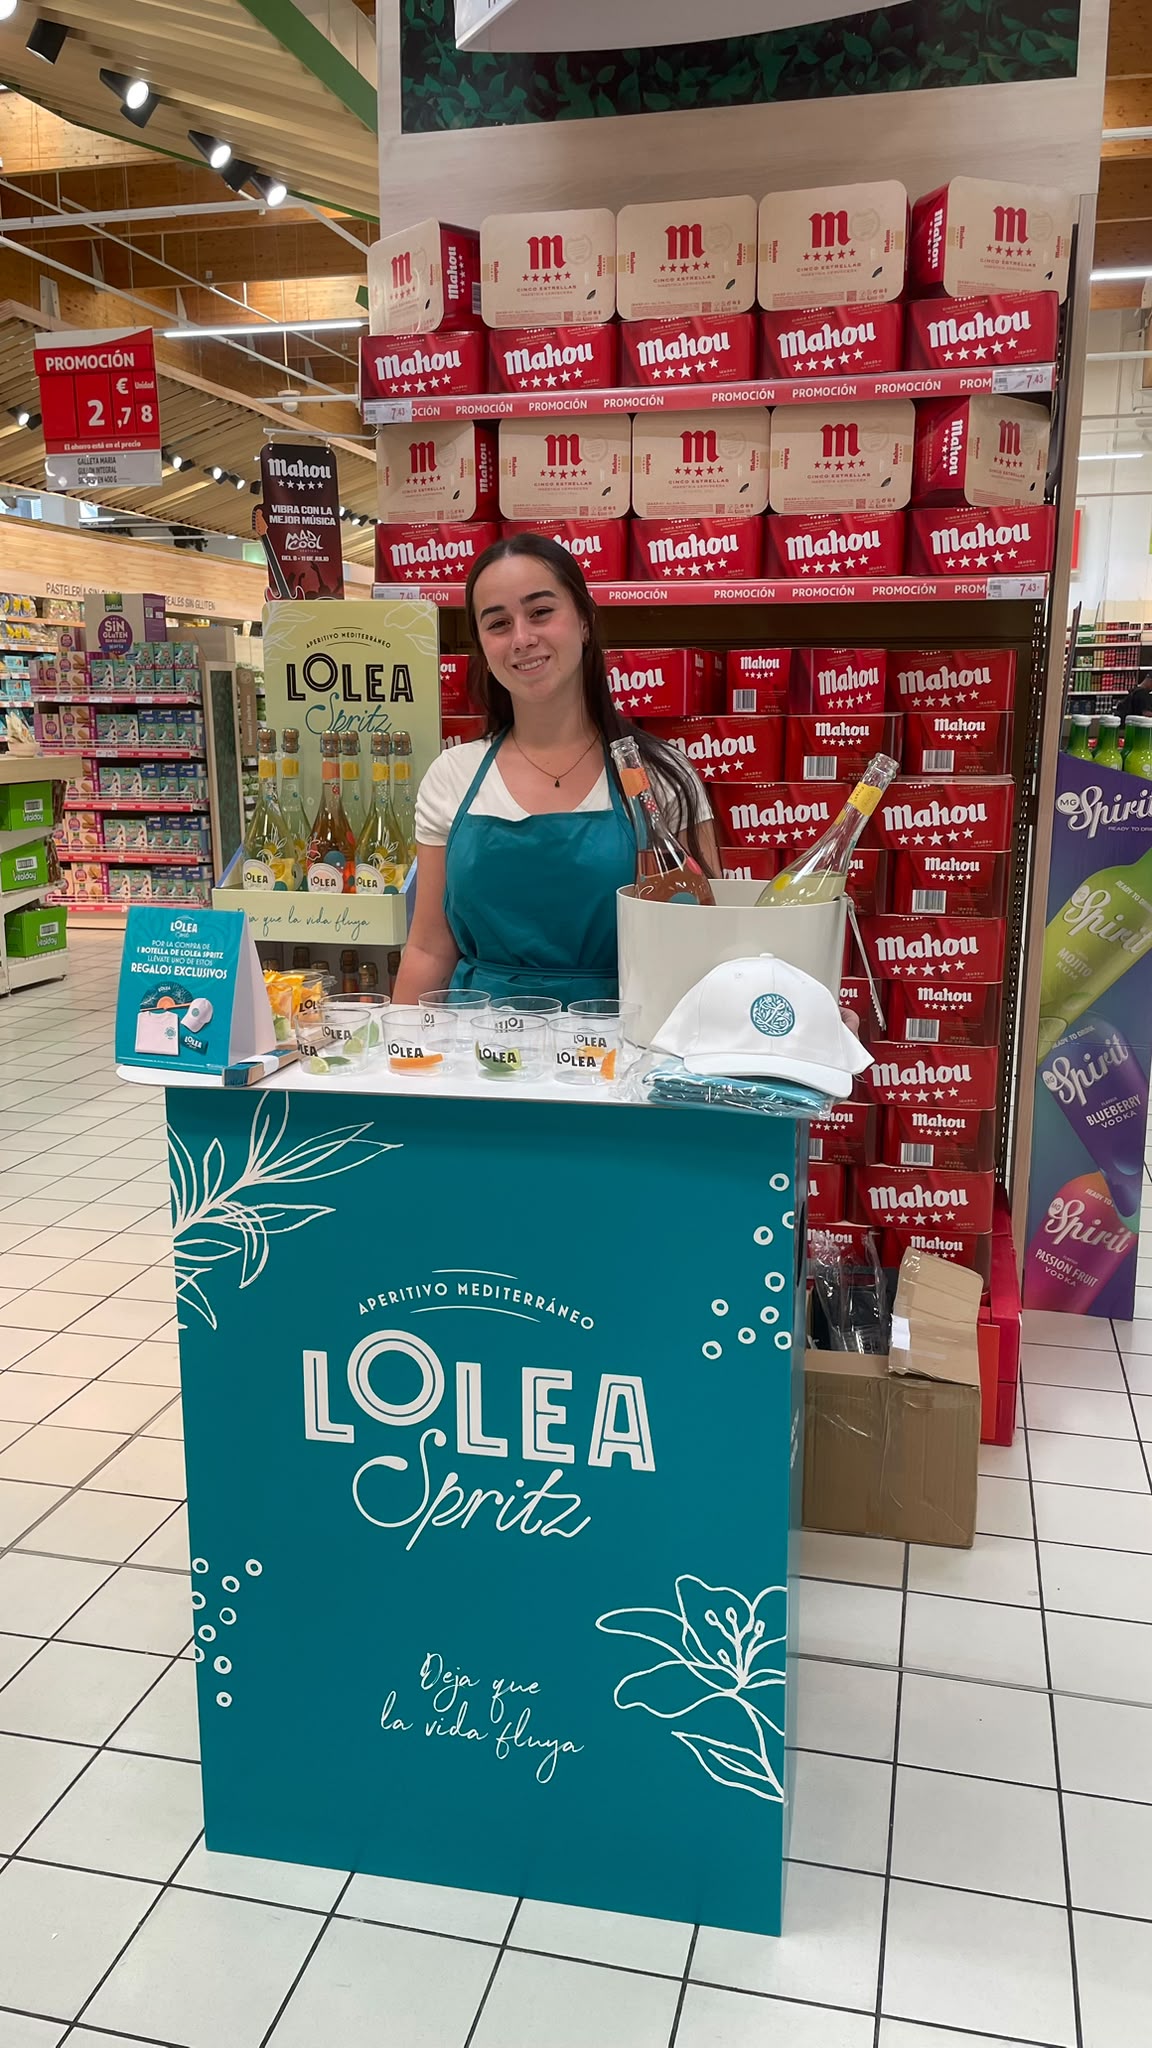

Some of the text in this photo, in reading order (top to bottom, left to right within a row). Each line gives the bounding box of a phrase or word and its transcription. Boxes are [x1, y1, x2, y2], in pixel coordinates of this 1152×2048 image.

[932, 208, 943, 269] Mahou
[447, 246, 459, 300] Mahou
[777, 322, 876, 358] Mahou
[927, 310, 1031, 348] Mahou
[45, 350, 135, 371] PROMOCIÓN
[503, 343, 594, 375] Mahou
[637, 332, 731, 366] Mahou
[375, 349, 462, 380] Mahou
[411, 405, 440, 417] OCIÓN
[455, 402, 514, 416] PROMOCIÓN
[528, 398, 588, 412] PROMOCIÓN
[603, 394, 664, 408] PROMOCIÓN
[711, 388, 775, 403] PROMOCIÓN
[792, 384, 857, 399] PROMOCIÓN
[874, 379, 941, 395] PROMOCIÓN
[121, 440, 141, 449] precio
[949, 419, 963, 476] Mahou
[267, 458, 331, 479] Mahou
[479, 443, 489, 493] Mahou
[269, 515, 336, 526] MEJOR MÚSICA
[271, 504, 333, 515] VIBRA CON LA
[389, 538, 475, 566] Mahou
[647, 533, 739, 564] Mahou
[785, 530, 881, 561] Mahou
[930, 522, 1031, 555] Mahou
[420, 591, 449, 601] OCIÓN
[608, 587, 668, 600] PROMOCIÓN
[713, 586, 776, 599] PROMOCIÓN
[792, 583, 855, 598] PROMOCIÓN
[872, 581, 937, 596] PROMOCIÓN
[306, 632, 339, 649] APERITIVO
[740, 654, 780, 671] Mahou
[286, 652, 414, 703] LOLEA
[606, 666, 665, 694] hou
[817, 665, 879, 696] Mahou
[897, 665, 992, 695] Mahou
[305, 691, 392, 735] Spritz
[933, 717, 986, 733] Mahou
[815, 721, 870, 737] Mahou
[729, 800, 830, 830] Mahou
[881, 801, 988, 831] Mahou
[924, 856, 980, 872] Mahou
[170, 920, 198, 933] LOLEA
[263, 916, 282, 937] que
[288, 905, 301, 924] la
[306, 906, 331, 925] vida
[141, 947, 169, 955] BOTELLA
[170, 948, 179, 956] DE
[180, 949, 201, 957] LOLEA
[202, 951, 224, 959] SPRITZ
[174, 941, 201, 949] COMPRA
[874, 932, 979, 962] Mahou
[131, 962, 228, 980] REGALOS EXCLUSIVOS
[1055, 961, 1079, 980] RUM
[1057, 947, 1093, 977] MOJITO
[299, 999, 317, 1012] LOL
[917, 986, 972, 1003] Mahou
[297, 1040, 319, 1057] LEA
[387, 1043, 424, 1058] LOLEA
[573, 1034, 608, 1048] LOLEA
[479, 1048, 517, 1064] LOLEA
[556, 1051, 597, 1067] LOLEA
[1059, 1033, 1129, 1106] Spirit
[869, 1060, 972, 1087] Mahou
[911, 1112, 966, 1129] Mahou
[1085, 1094, 1141, 1126] BLUEBERRY
[1101, 1110, 1137, 1129] VODKA
[868, 1184, 969, 1210] Mahou
[1045, 1199, 1131, 1253] Spirit
[910, 1235, 963, 1251] Mahou
[1035, 1249, 1099, 1288] PASSION FRUIT
[1045, 1266, 1077, 1287] VODKA
[358, 1282, 595, 1330] APERITIVO MEDITERRÁNEO
[302, 1329, 656, 1472] LOLEA
[352, 1428, 592, 1551] Spritz
[419, 1652, 542, 1723] Deja que
[380, 1690, 585, 1784] la vida fluya
